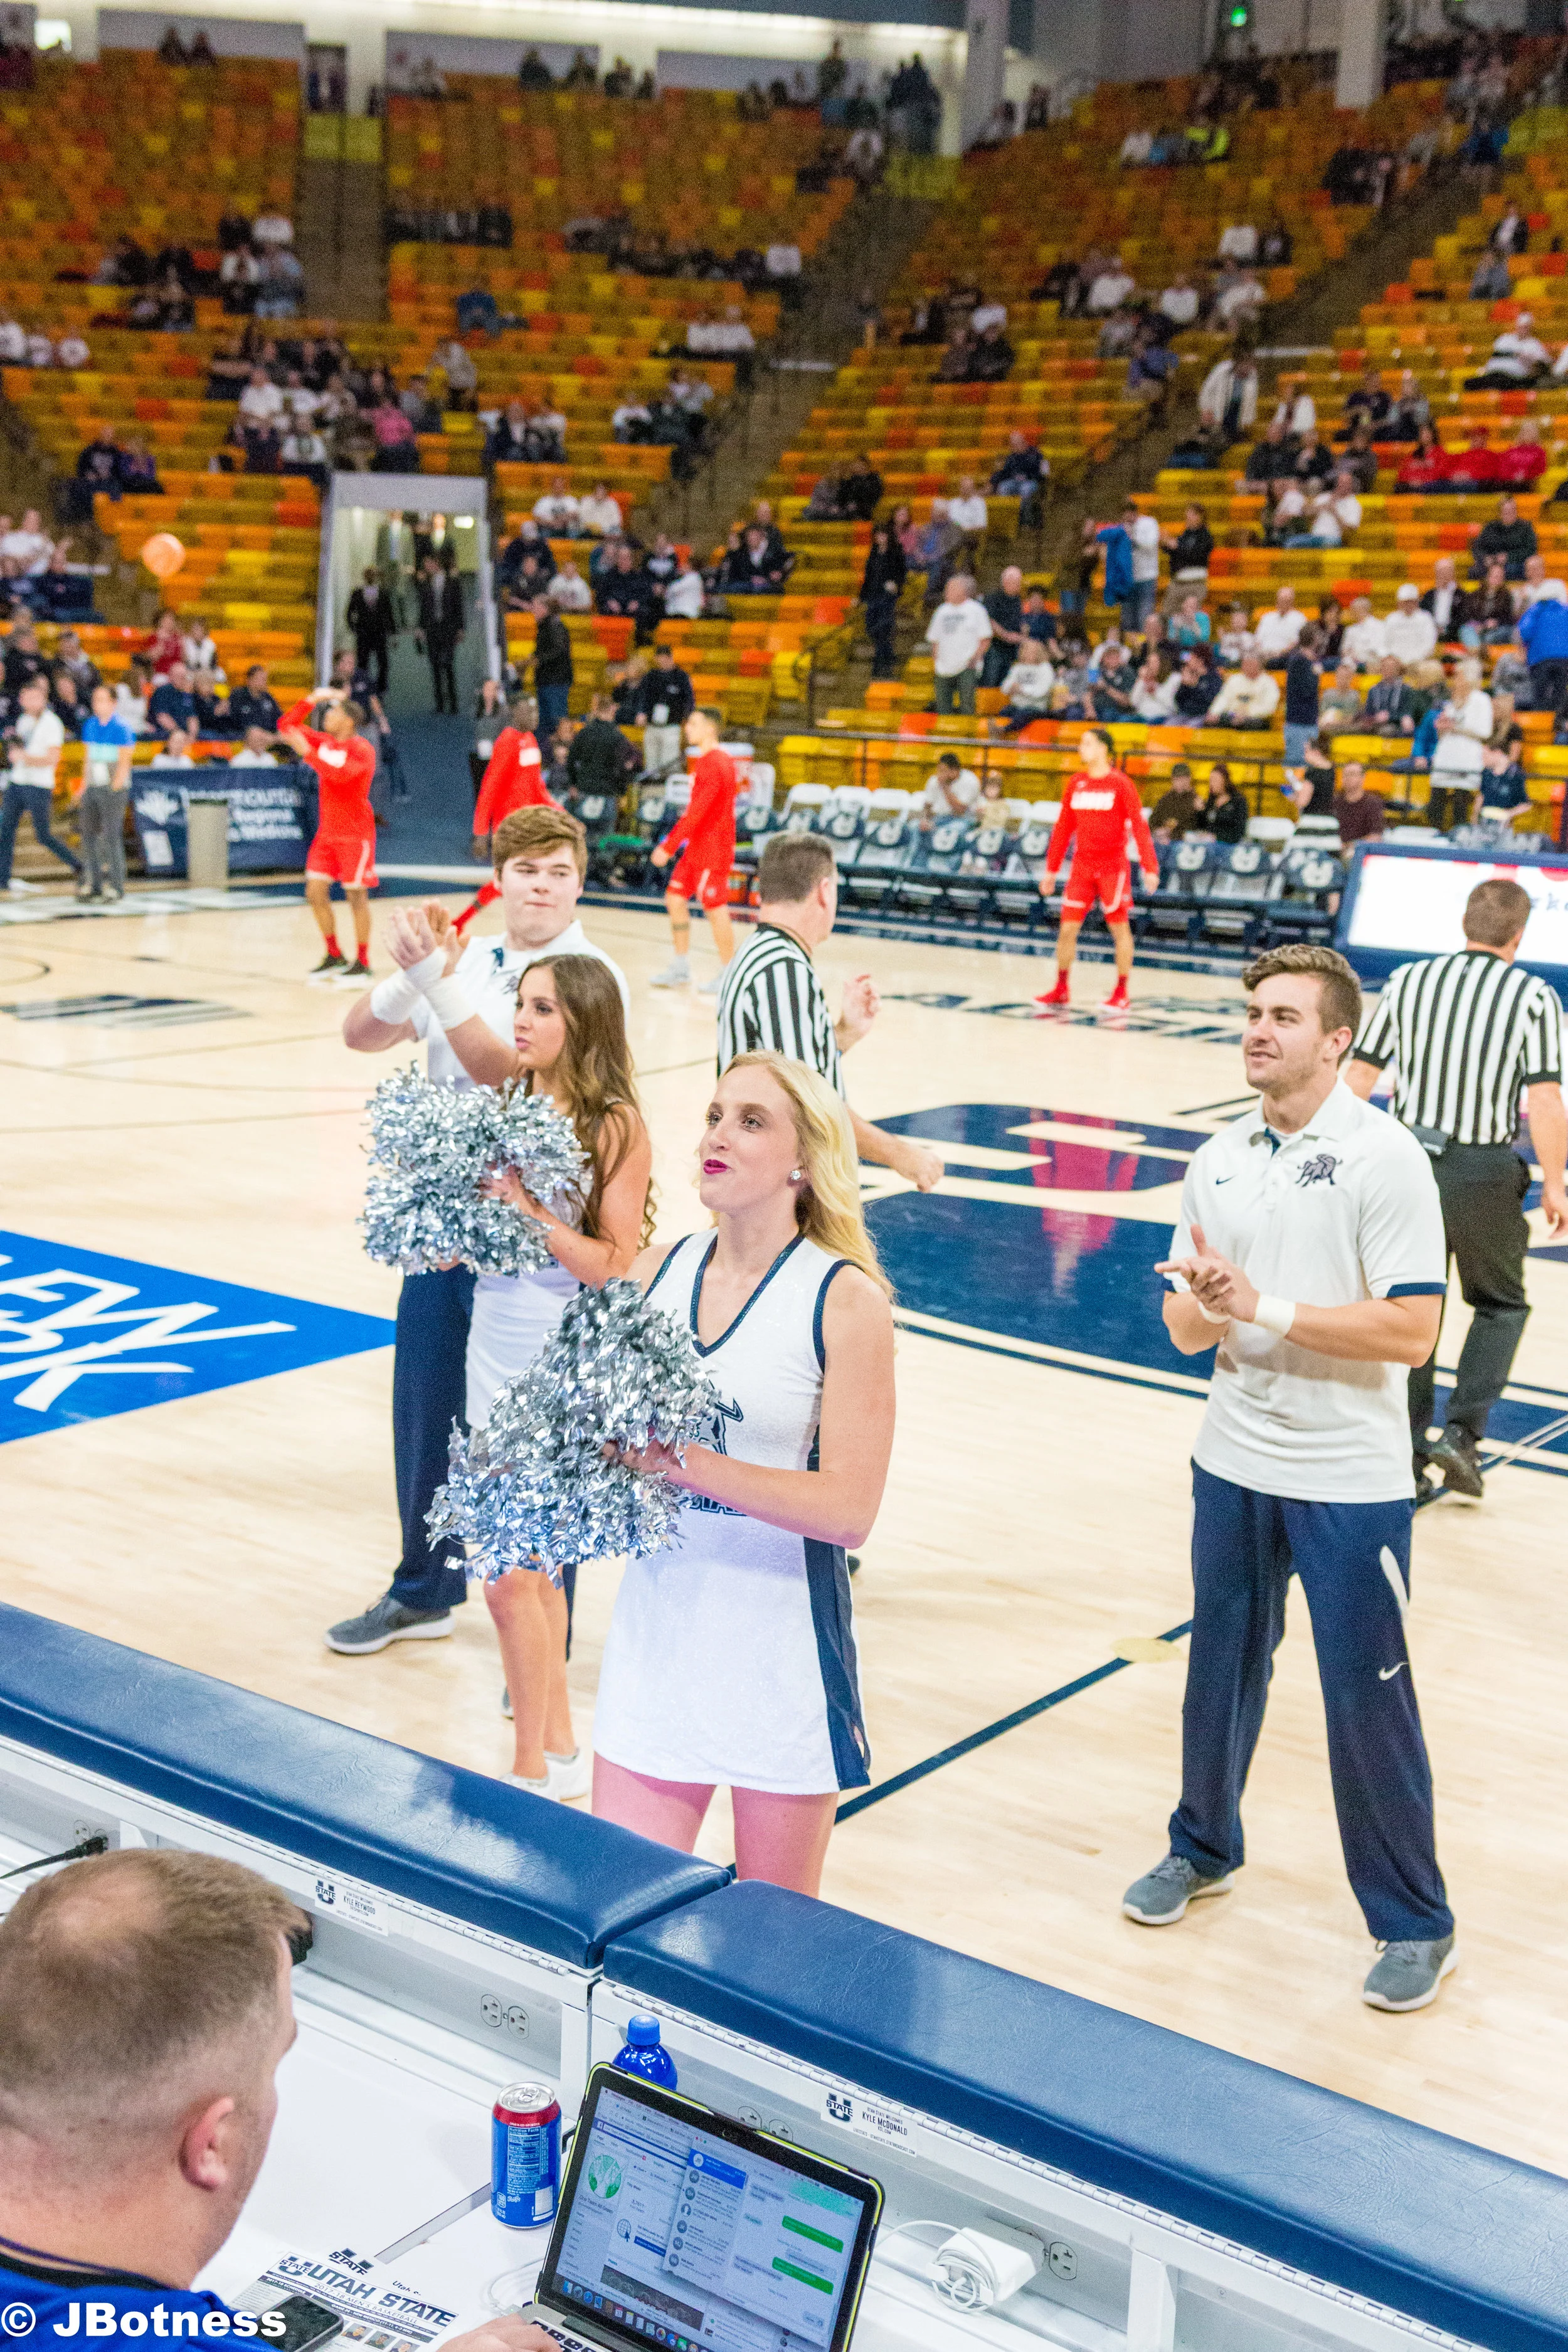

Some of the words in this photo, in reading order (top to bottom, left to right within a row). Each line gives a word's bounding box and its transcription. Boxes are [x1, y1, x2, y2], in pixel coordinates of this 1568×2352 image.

[315, 1885, 336, 1900] STATE
[344, 1895, 354, 1906] KYLE
[354, 1899, 376, 1915] HEYWOOD
[826, 2099, 853, 2117] STATE
[862, 2111, 876, 2124] KYLE
[886, 2113, 903, 2124] WELCOMES
[279, 2259, 311, 2274] STATE
[307, 2264, 376, 2299] UTAH
[378, 2293, 457, 2328] STATE
[315, 2283, 345, 2299] 2017-18
[347, 2297, 370, 2309] MEN'S
[373, 2306, 418, 2324] BASKETBALL
